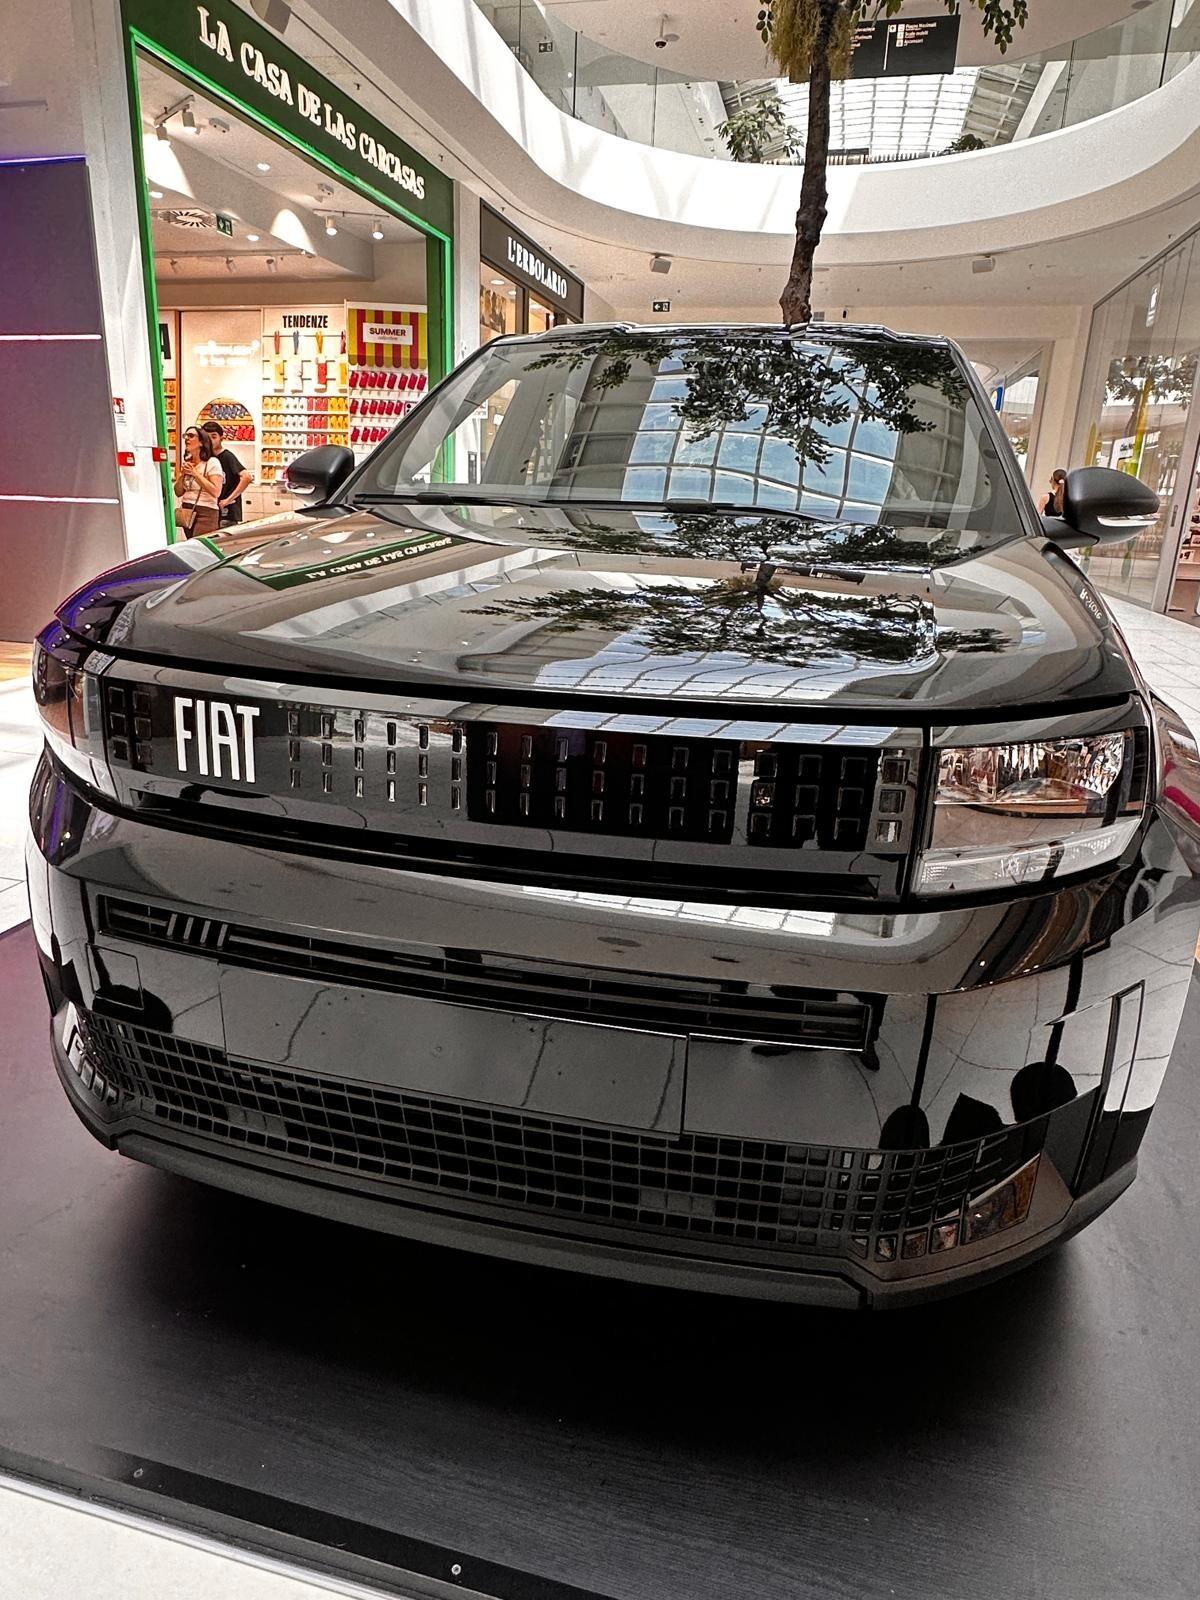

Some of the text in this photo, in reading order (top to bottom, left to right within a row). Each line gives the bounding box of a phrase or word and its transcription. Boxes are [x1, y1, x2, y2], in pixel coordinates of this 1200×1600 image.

[197, 6, 425, 200] LA CASA DE LAS CARCASAS
[507, 236, 567, 299] L'ERBOLARIO
[282, 315, 329, 329] TENDENZE
[369, 327, 406, 337] SUMMER
[174, 696, 260, 783] FIAT
